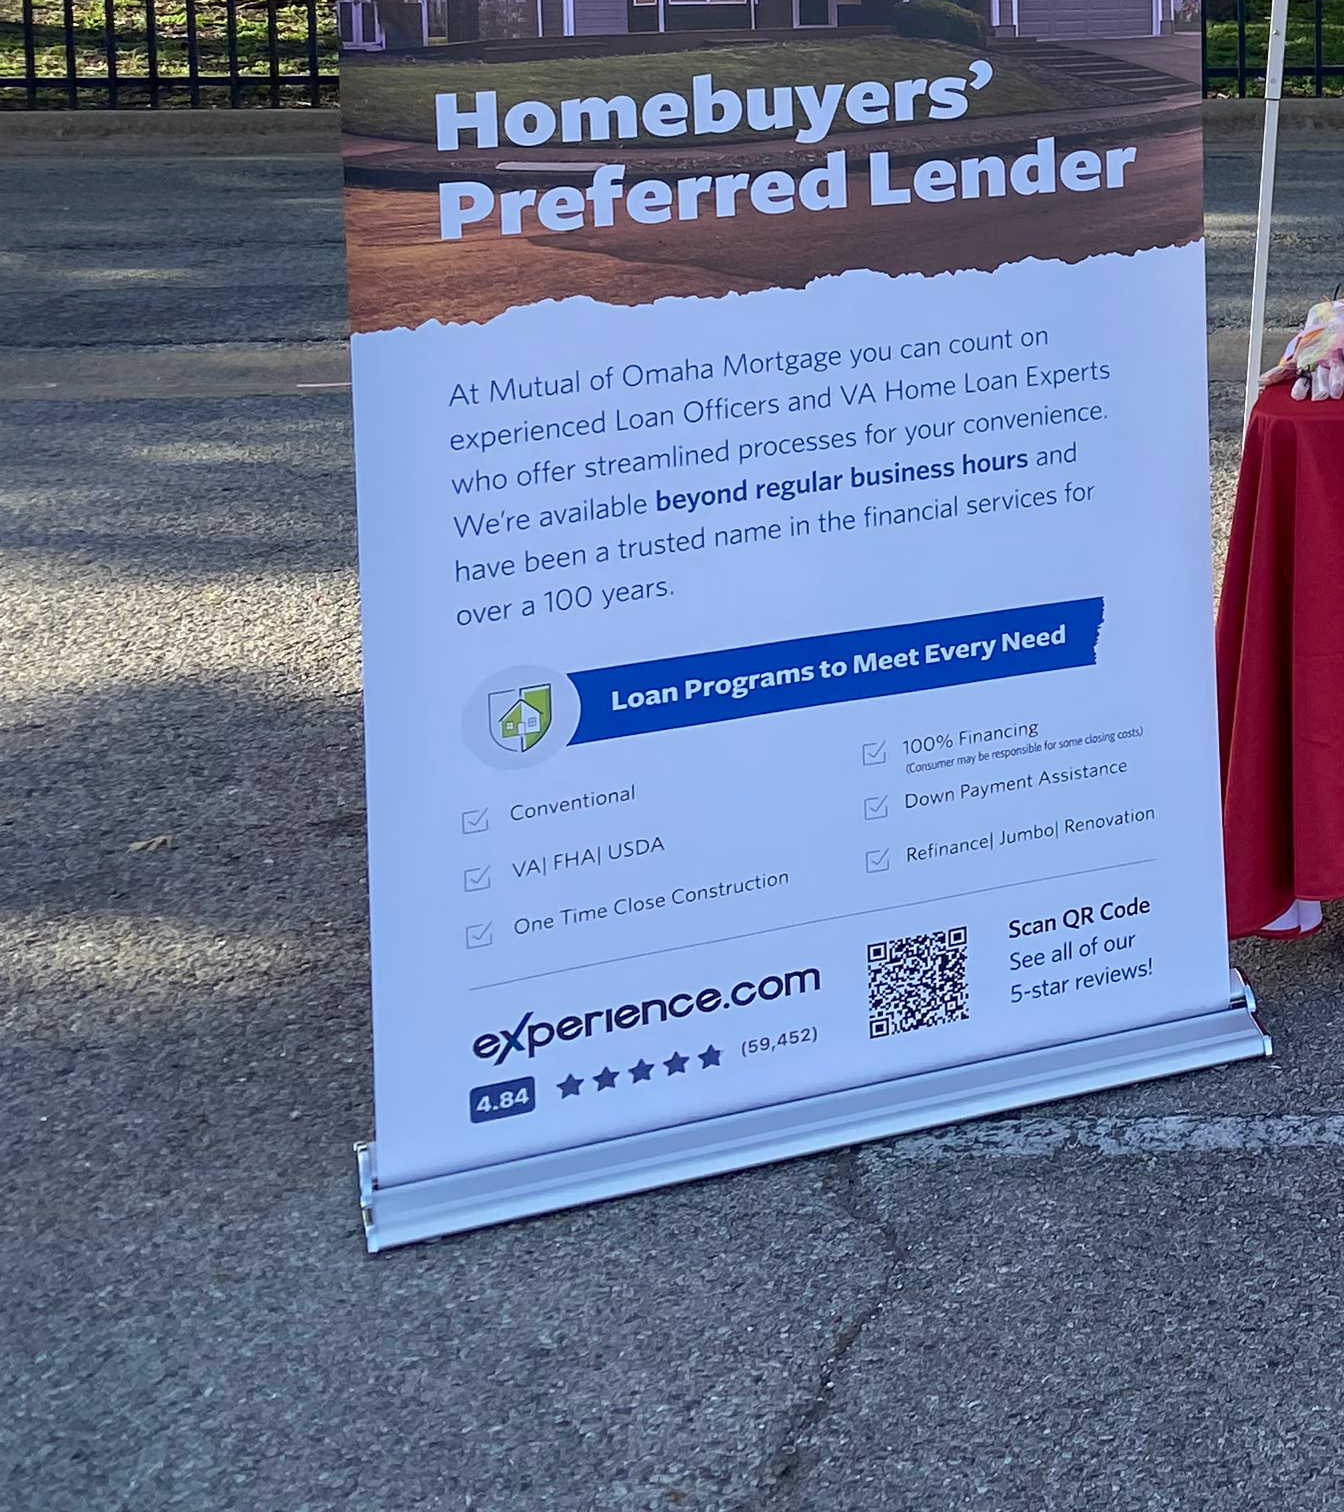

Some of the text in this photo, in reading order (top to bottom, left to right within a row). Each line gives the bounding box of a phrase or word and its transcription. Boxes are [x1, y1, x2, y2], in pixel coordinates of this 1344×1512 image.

[435, 60, 993, 151] Homebuyers'
[437, 137, 1137, 242] Preferred Lender
[449, 329, 1048, 407] At Mutual of Omaha Mortgage you can count on
[457, 581, 674, 626] over a 100 years.
[612, 624, 1065, 711] Loan Programs to Meet Every Need
[903, 723, 1039, 754] 100% Financing
[906, 726, 1143, 774] (Consumer may be responsible for some closing costs)
[510, 784, 635, 821] Conventional
[905, 762, 1127, 808] Down Payment Assistance
[1065, 809, 1154, 834] Renovation
[608, 837, 665, 860] USDA
[514, 873, 788, 934] One Time Close Construction
[1009, 897, 1150, 938] Scan QR Code
[1010, 934, 1136, 970] See all of our
[1011, 957, 1152, 1003] 5-star reviews!
[473, 968, 820, 1066] experience.com
[742, 1026, 817, 1057] (59,452)
[477, 1088, 529, 1112] 4.84
